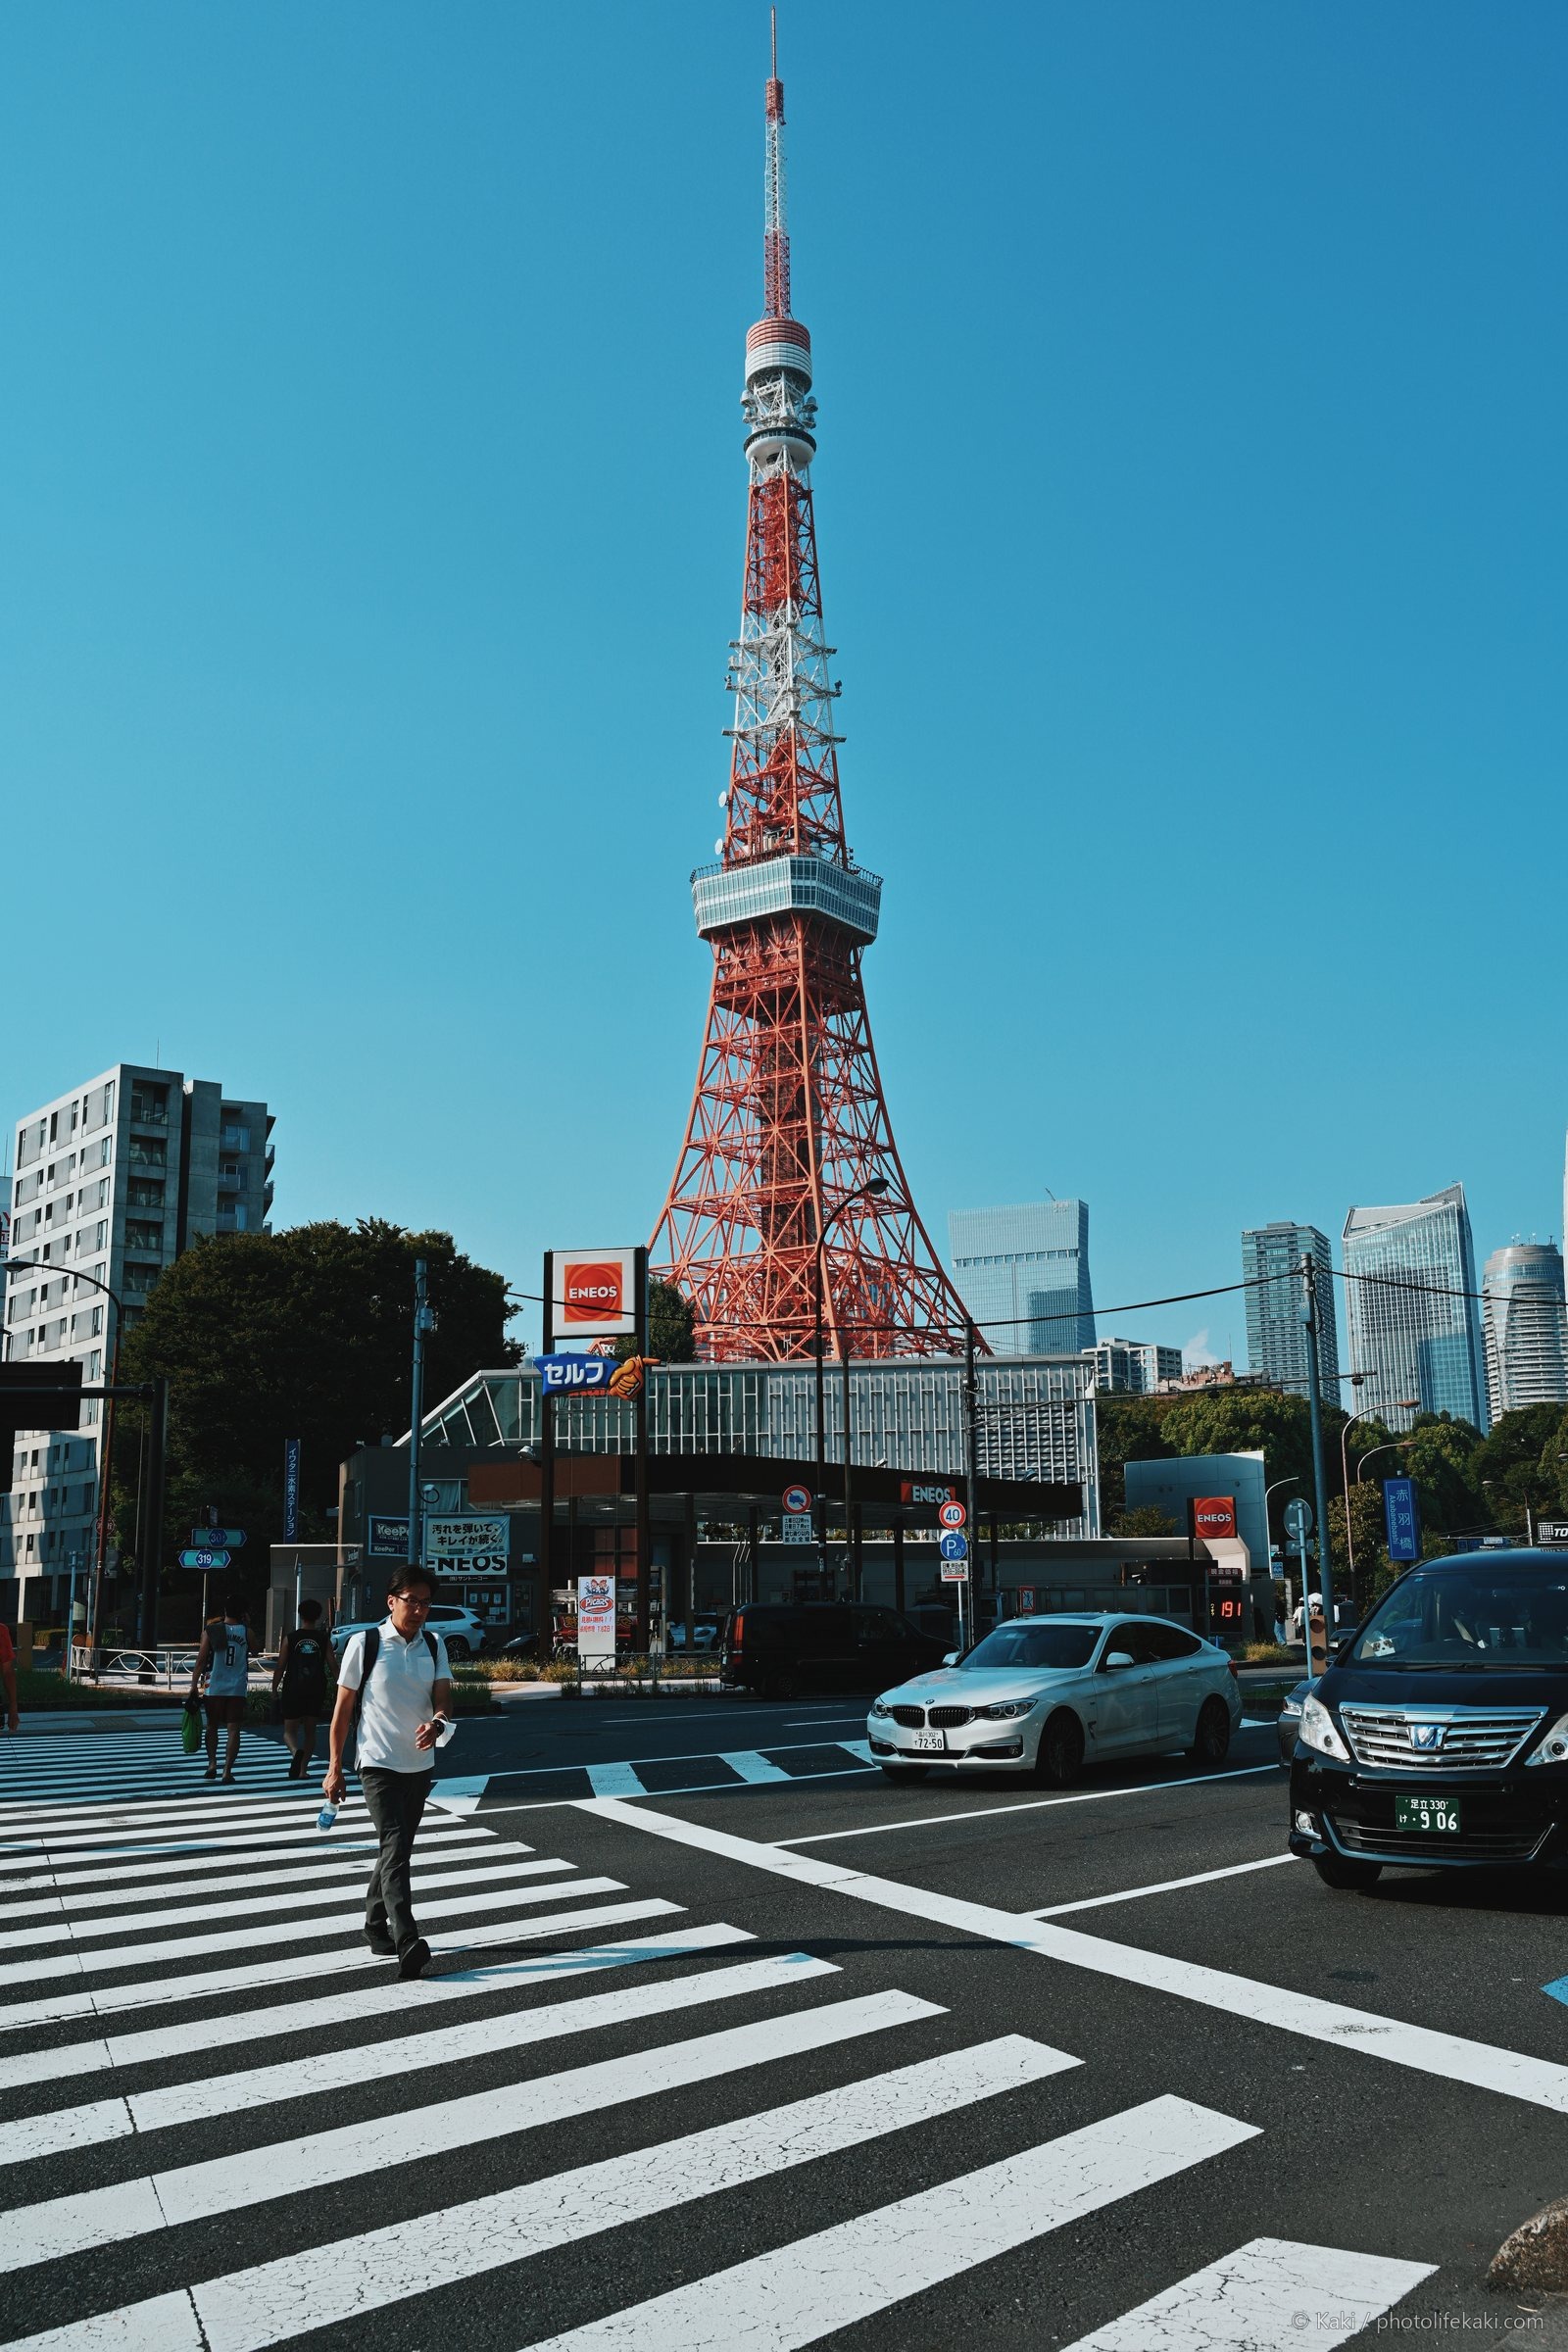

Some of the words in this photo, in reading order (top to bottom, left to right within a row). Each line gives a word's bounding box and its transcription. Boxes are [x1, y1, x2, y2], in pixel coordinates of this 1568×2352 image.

[569, 1286, 617, 1298] ENEOS
[544, 1362, 604, 1385] セルフ
[286, 1447, 297, 1537] イワタニ水素ステーション
[912, 1486, 951, 1504] ENEOS
[946, 1509, 960, 1521] 40
[1197, 1513, 1232, 1522] ENEOS
[1389, 1494, 1399, 1544] Akabanebashi
[1396, 1489, 1412, 1550] 赤羽橋
[376, 1524, 411, 1537] KeeP
[432, 1523, 498, 1535] 汚れを弾いて、
[437, 1535, 503, 1545] キレイが続く。
[197, 1553, 212, 1564] 319
[1221, 1601, 1241, 1617] 191
[226, 1645, 235, 1666] 8
